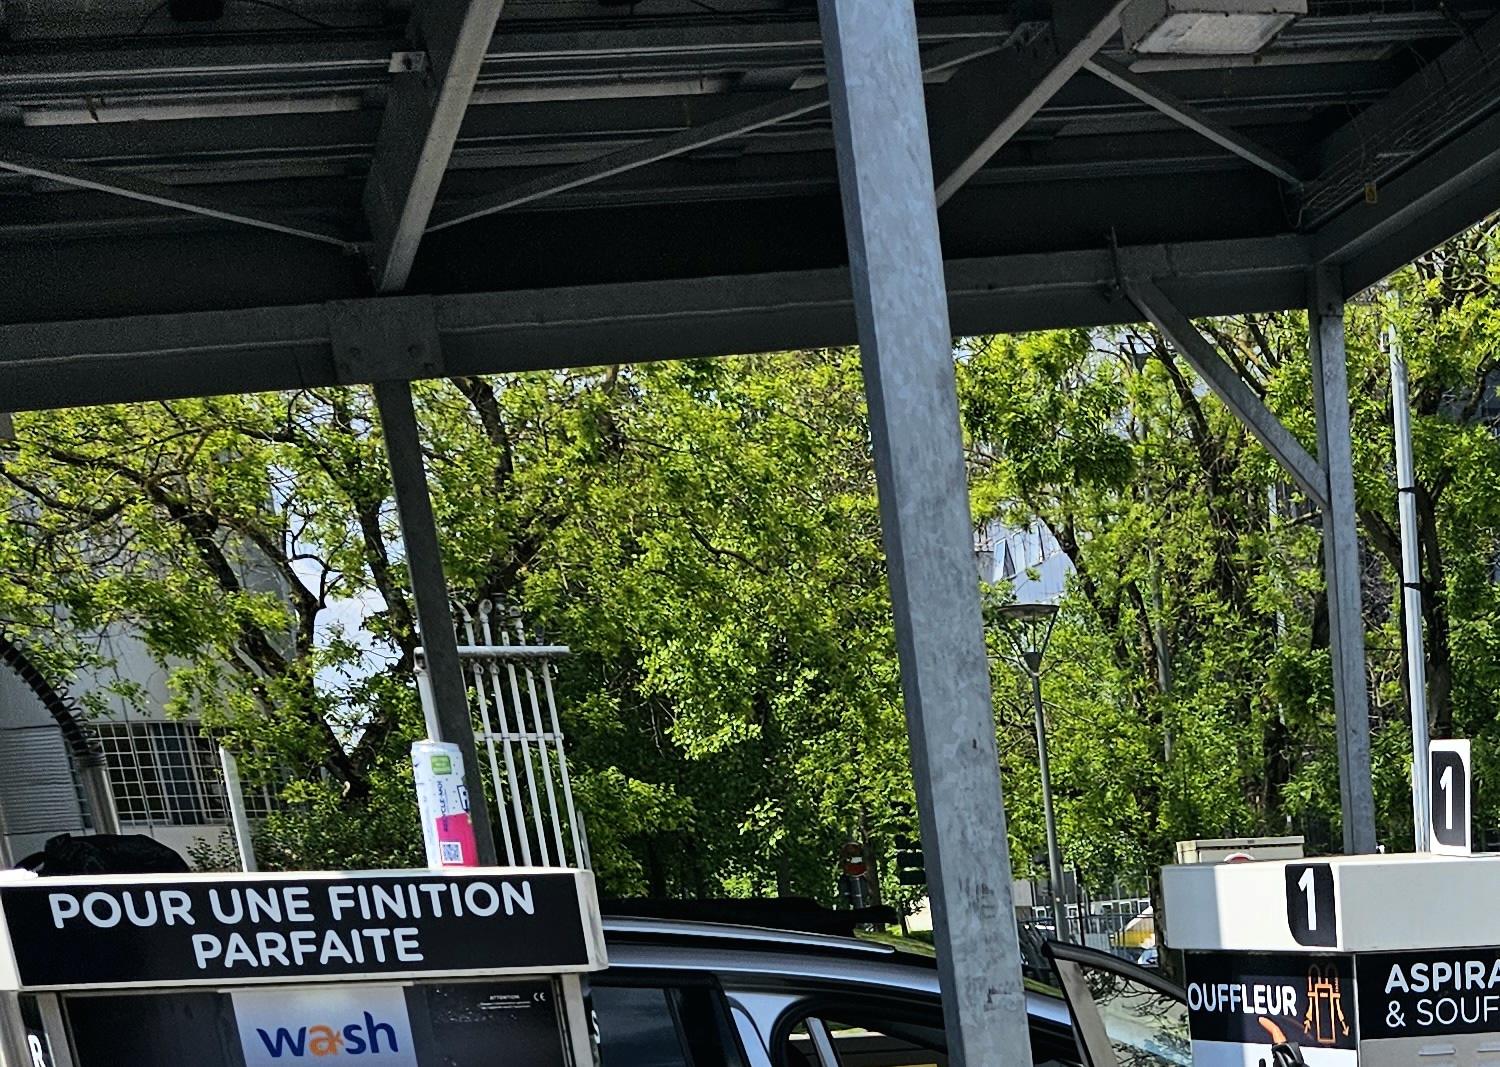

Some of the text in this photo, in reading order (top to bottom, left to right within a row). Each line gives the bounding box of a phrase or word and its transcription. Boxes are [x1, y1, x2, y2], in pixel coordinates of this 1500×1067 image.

[1440, 766, 1452, 829] 1
[49, 881, 534, 928] POUR UNE FINITION
[1298, 868, 1316, 930] 1
[192, 928, 423, 968] PARFAITE
[256, 1011, 398, 1059] wash
[1386, 1001, 1406, 1027] &
